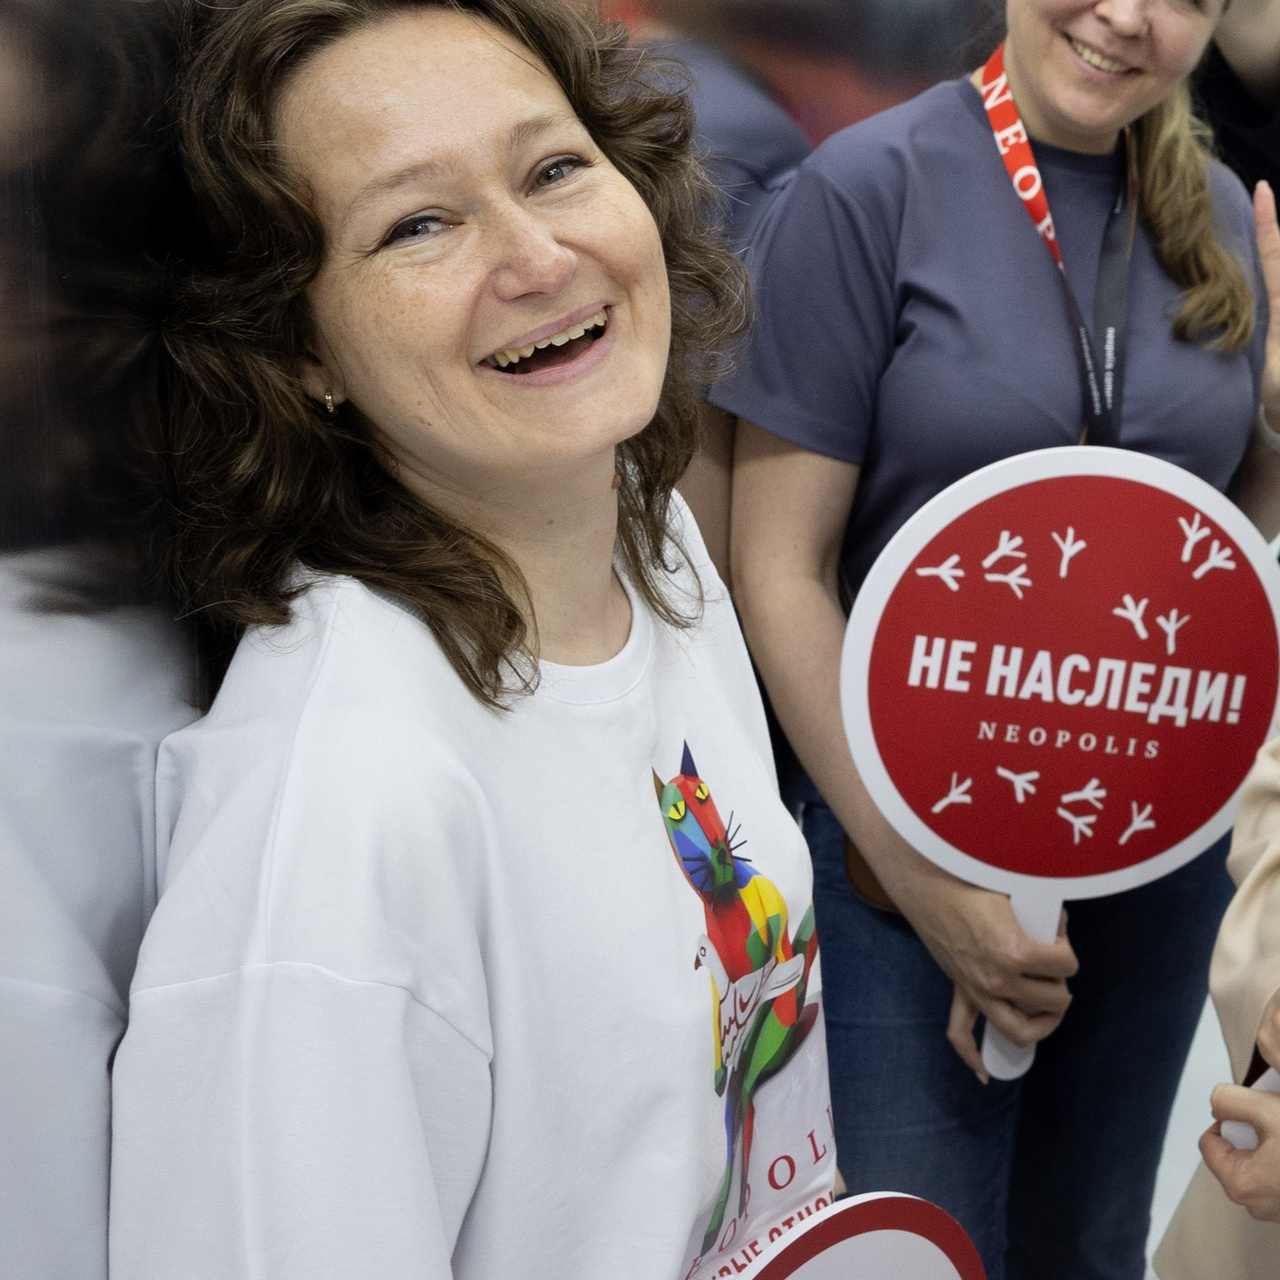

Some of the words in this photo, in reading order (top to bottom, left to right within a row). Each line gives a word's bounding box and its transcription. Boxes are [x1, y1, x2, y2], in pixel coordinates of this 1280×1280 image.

[906, 634, 977, 692] НЕ
[985, 644, 1247, 727] НАСЛЕДИ!
[977, 720, 1161, 759] NEOPOLIS
